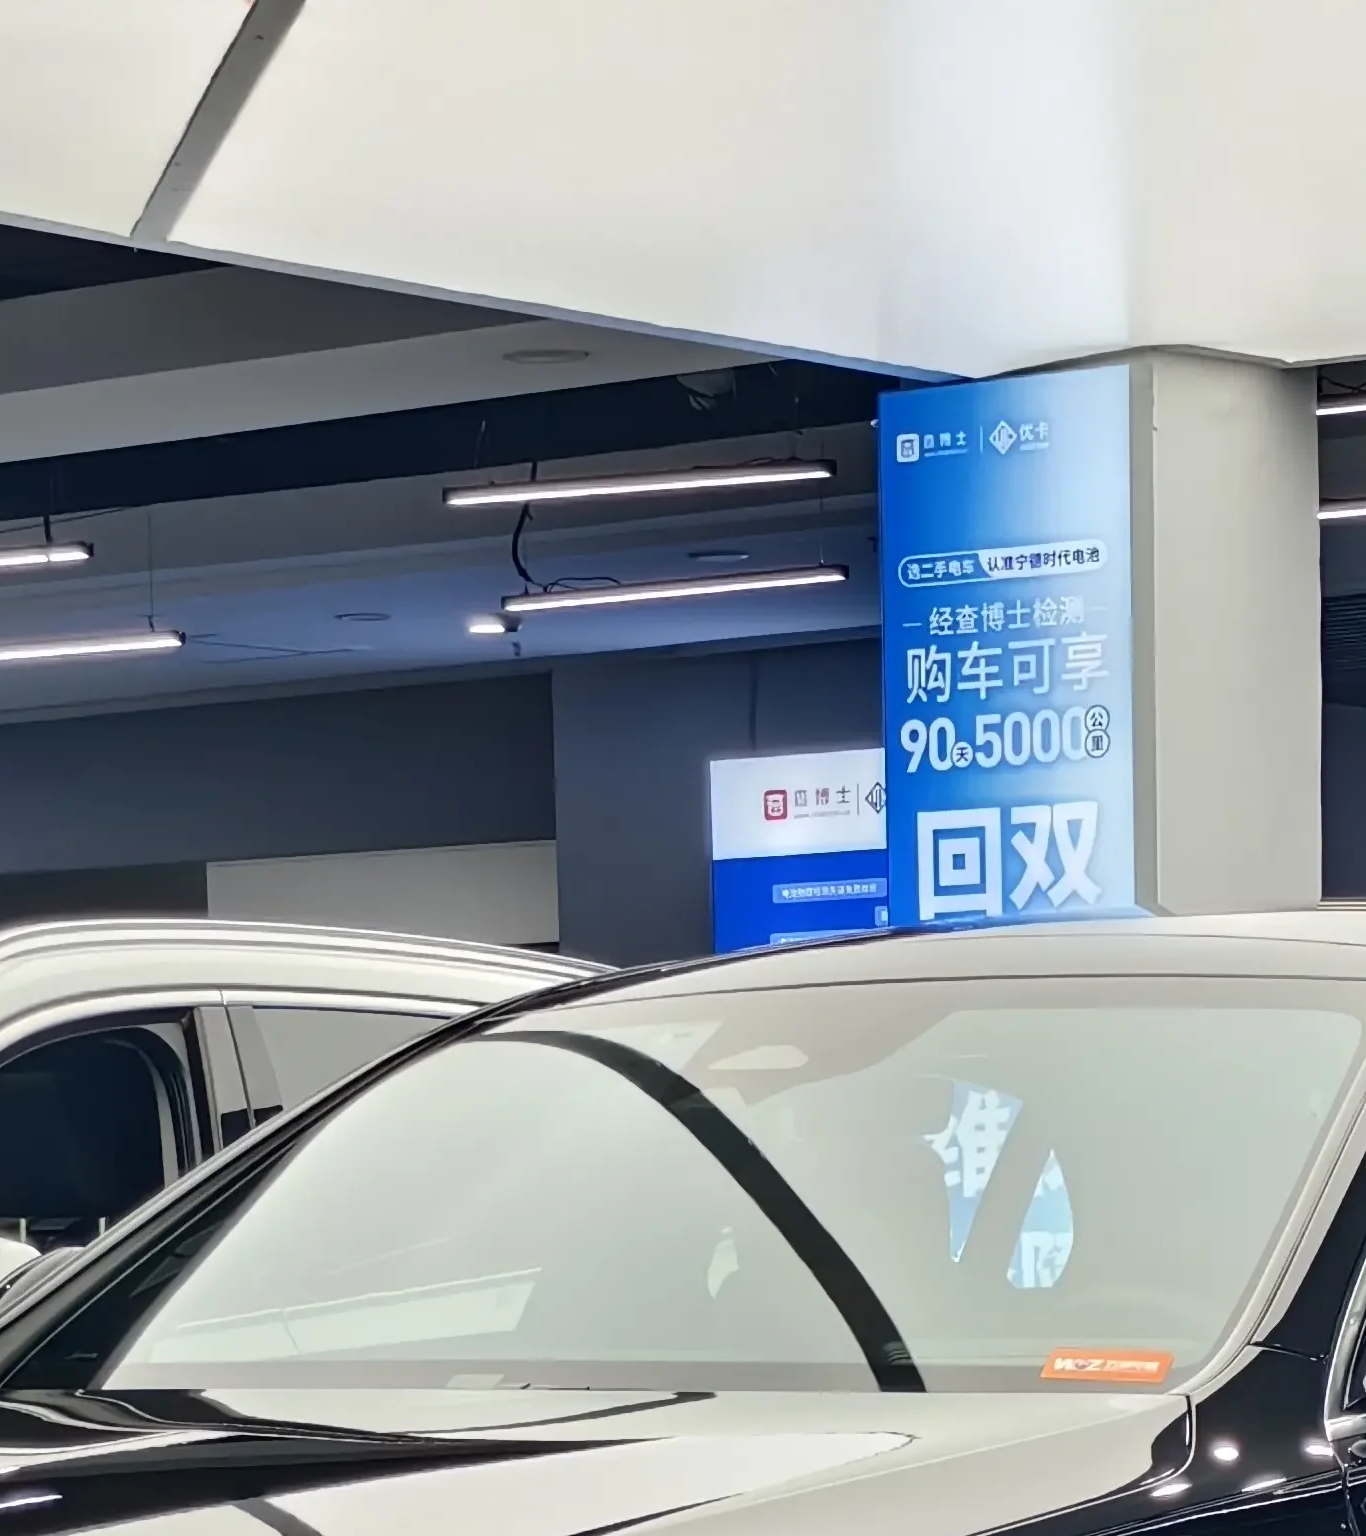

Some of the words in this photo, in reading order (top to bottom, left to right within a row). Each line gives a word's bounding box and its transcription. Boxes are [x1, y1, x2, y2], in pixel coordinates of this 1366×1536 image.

[928, 596, 1084, 636] 经查博士检测
[906, 631, 1110, 704] 购车可享
